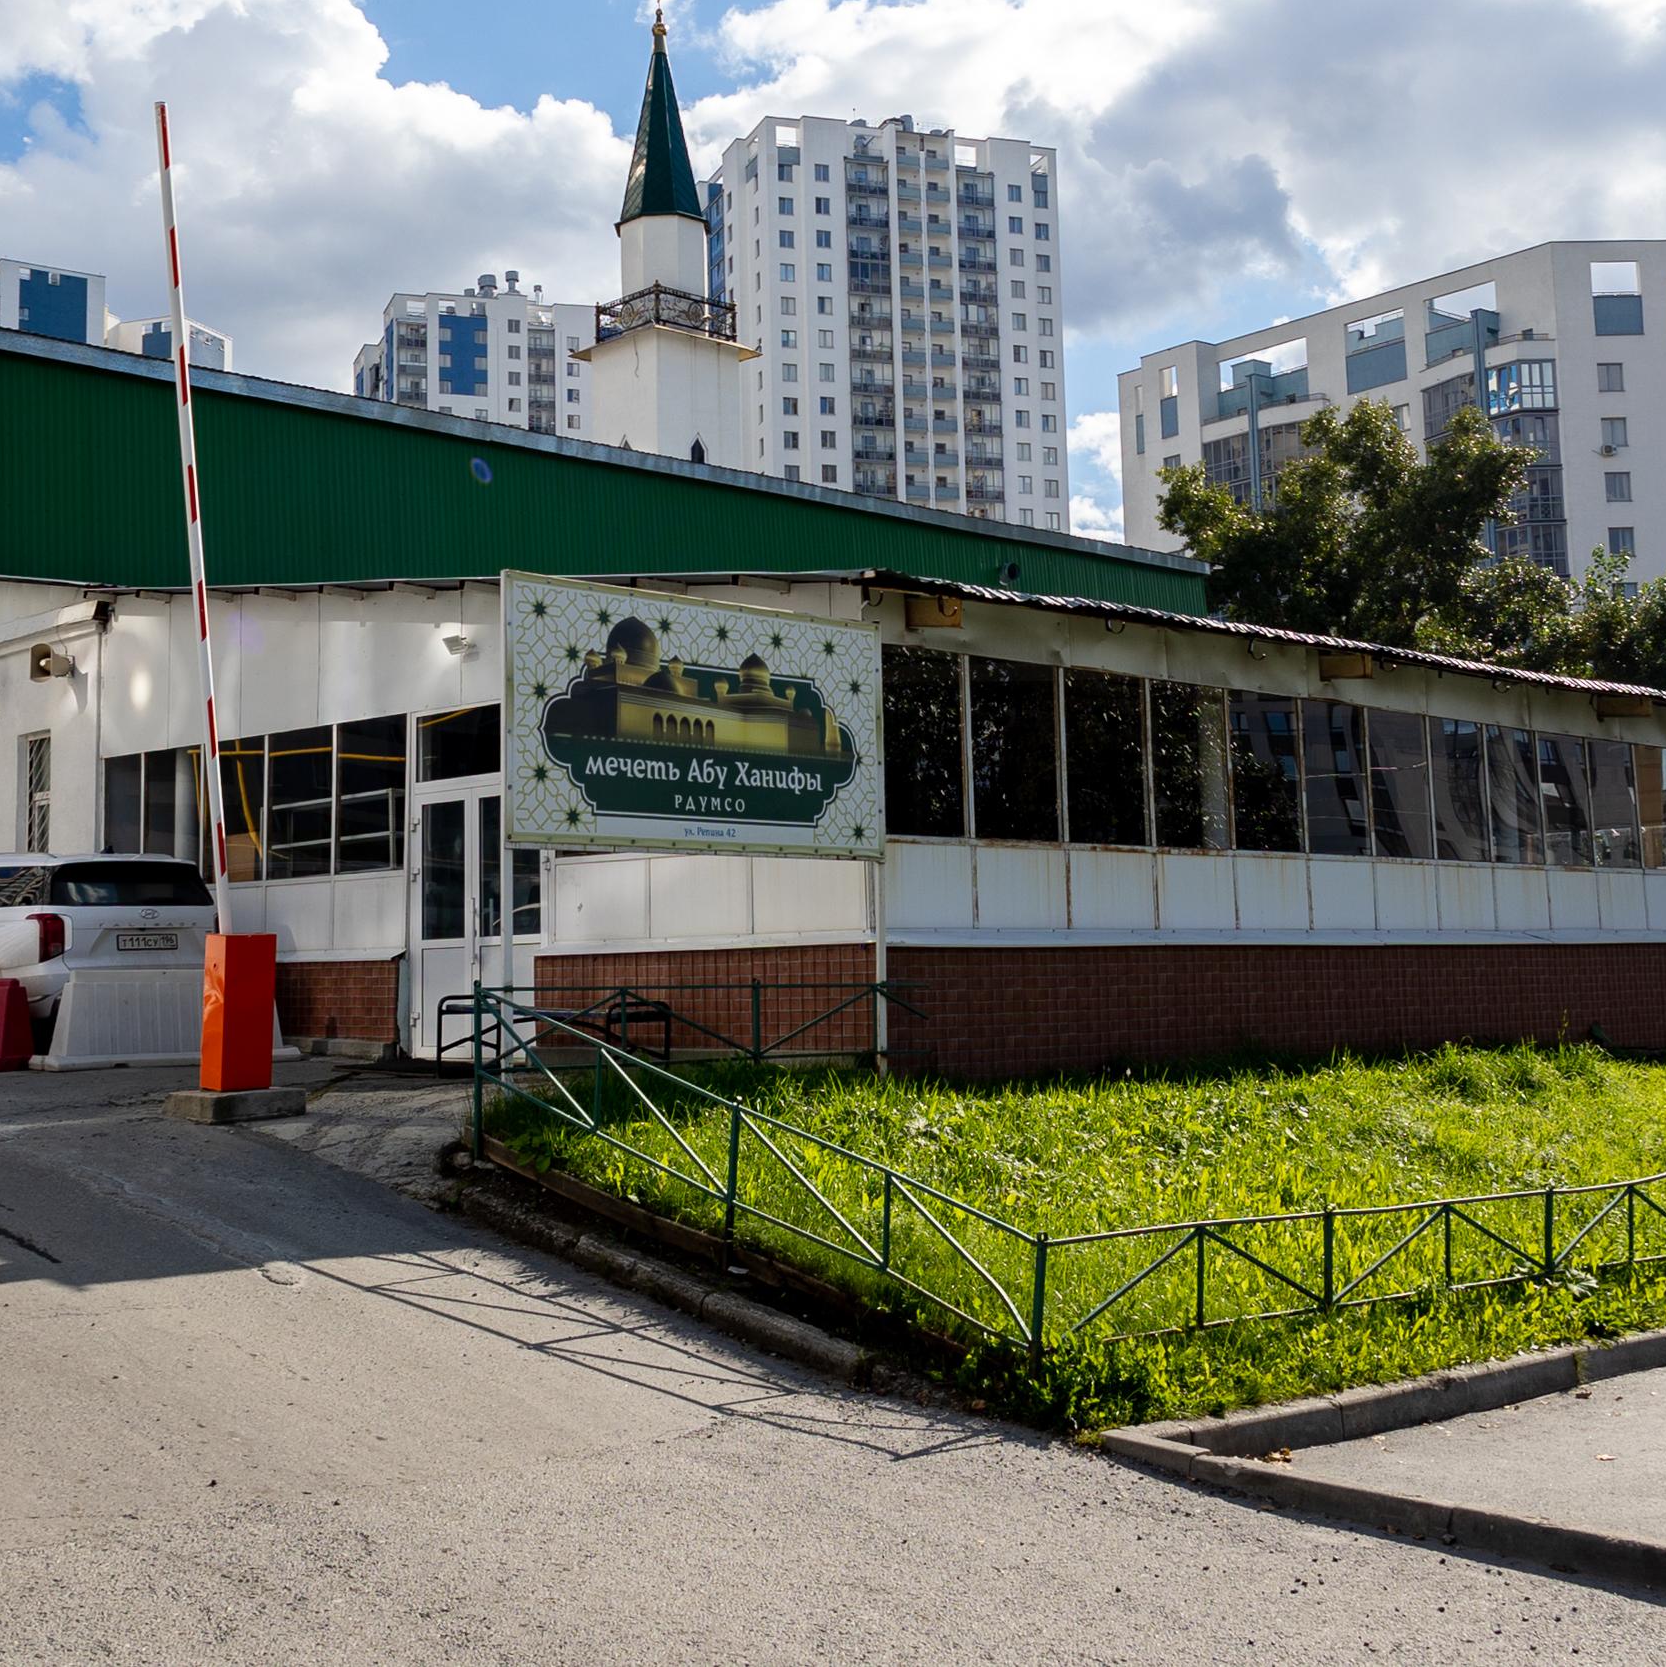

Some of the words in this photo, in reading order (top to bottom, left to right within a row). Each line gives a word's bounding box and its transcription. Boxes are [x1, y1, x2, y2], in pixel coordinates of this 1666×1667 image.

[687, 757, 728, 789] Абу
[734, 761, 823, 794] Ханифы
[674, 794, 746, 813] РАУМСО
[697, 826, 724, 837] Репина
[726, 827, 736, 838] 42
